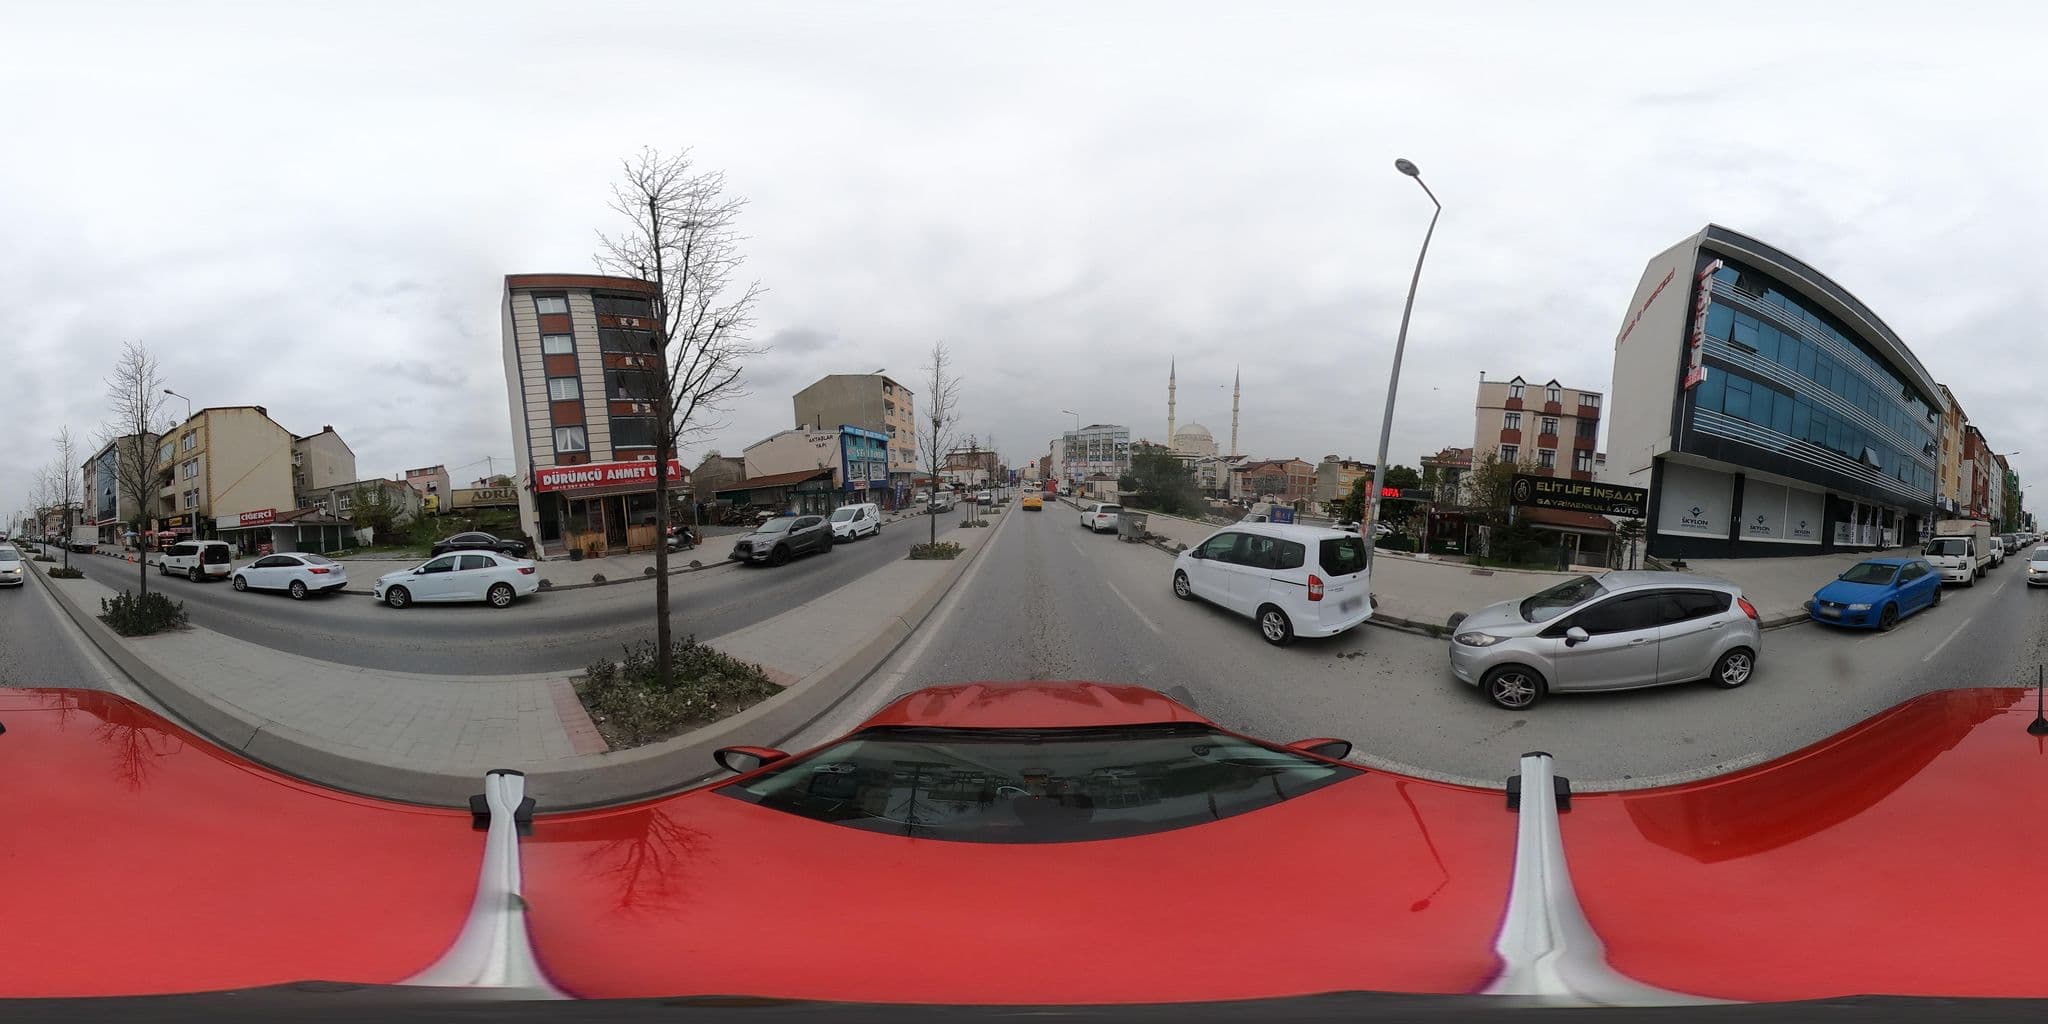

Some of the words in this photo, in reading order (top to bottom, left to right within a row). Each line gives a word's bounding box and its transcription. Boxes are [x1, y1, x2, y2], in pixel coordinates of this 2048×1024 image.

[543, 468, 602, 486] DÜRÜMCÜ
[607, 466, 645, 480] AHMET
[649, 465, 676, 478] UA
[1565, 484, 1591, 497] LİFE
[1593, 486, 1643, 502] İNŞAAT
[1613, 507, 1639, 515] AUTO
